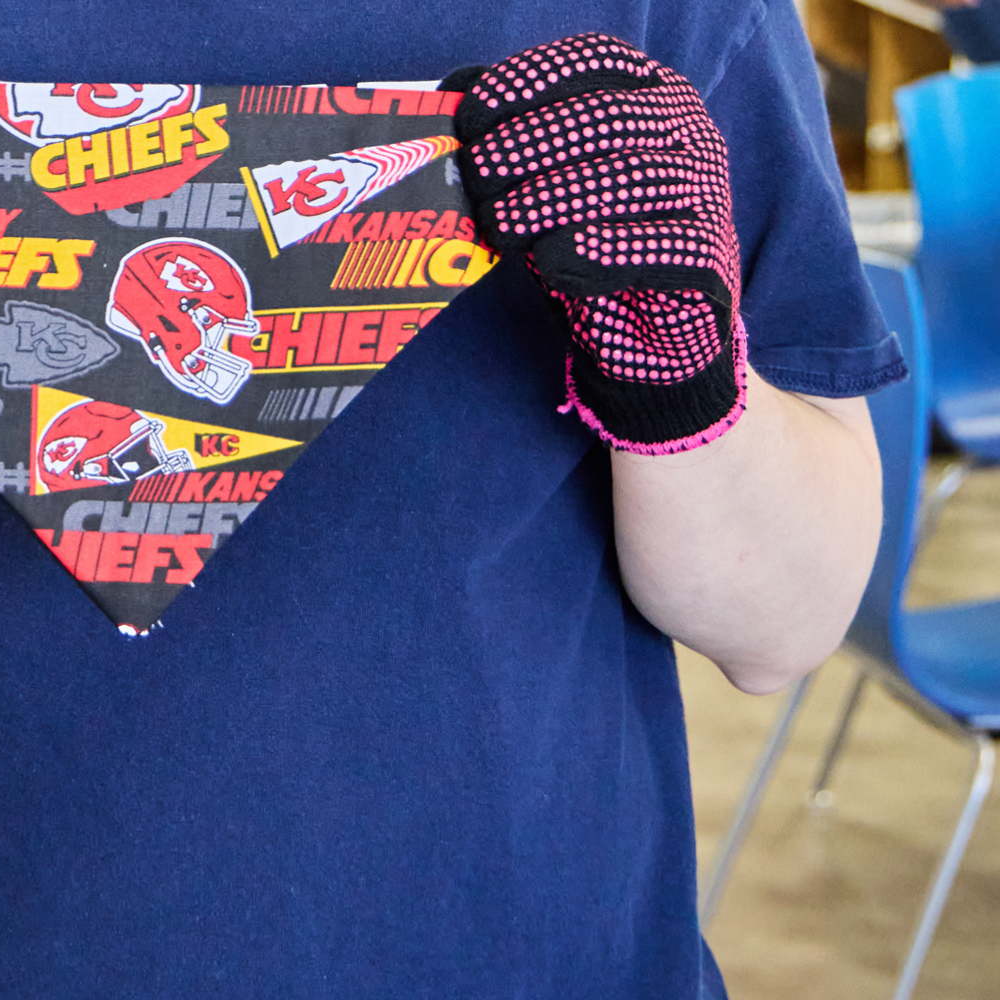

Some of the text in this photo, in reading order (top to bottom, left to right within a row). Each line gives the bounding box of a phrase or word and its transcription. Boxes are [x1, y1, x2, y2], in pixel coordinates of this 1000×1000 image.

[30, 103, 230, 193] CHIEFS
[263, 166, 349, 217] KC
[325, 210, 476, 243] KANSAS
[15, 320, 87, 369] KC
[230, 308, 443, 368] CHIEF
[194, 433, 240, 457] KC
